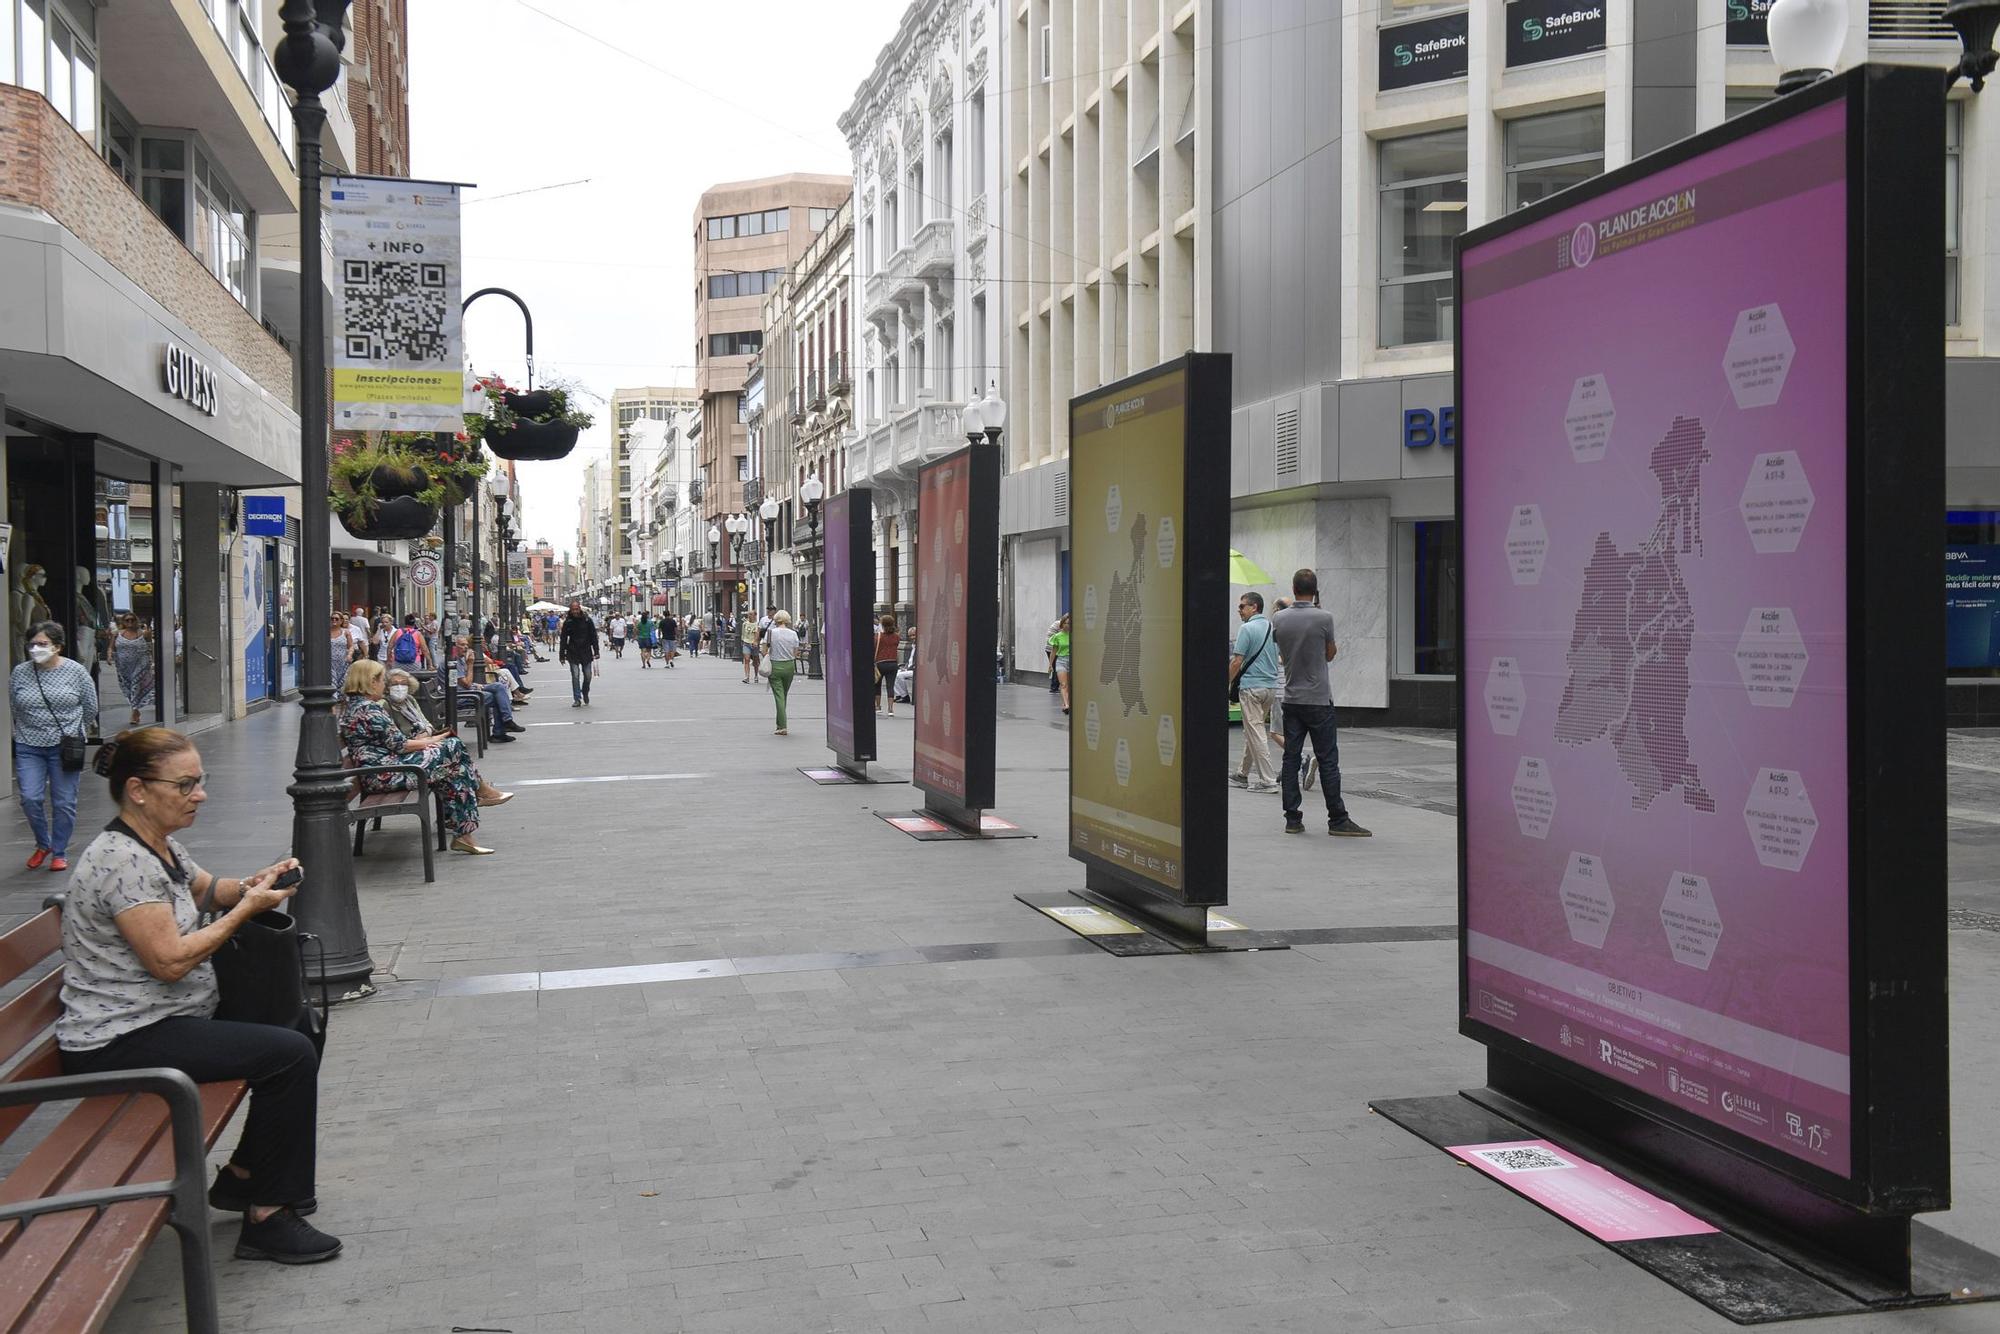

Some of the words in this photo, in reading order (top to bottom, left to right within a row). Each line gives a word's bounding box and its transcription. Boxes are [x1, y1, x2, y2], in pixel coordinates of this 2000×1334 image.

[1546, 8, 1600, 28] SafeBrok
[1546, 27, 1572, 37] Europe
[1415, 35, 1465, 54] SafeBrok
[1415, 53, 1439, 62] Europe
[1600, 213, 1629, 239] PLAN
[1631, 206, 1646, 229] DE
[384, 242, 424, 254] INFO
[166, 342, 218, 416] GUESS
[356, 374, 442, 386] Inscripciones:
[1972, 574, 1991, 582] mejor
[1770, 772, 1788, 782] Acción
[1608, 982, 1636, 1000] OBJETIVO
